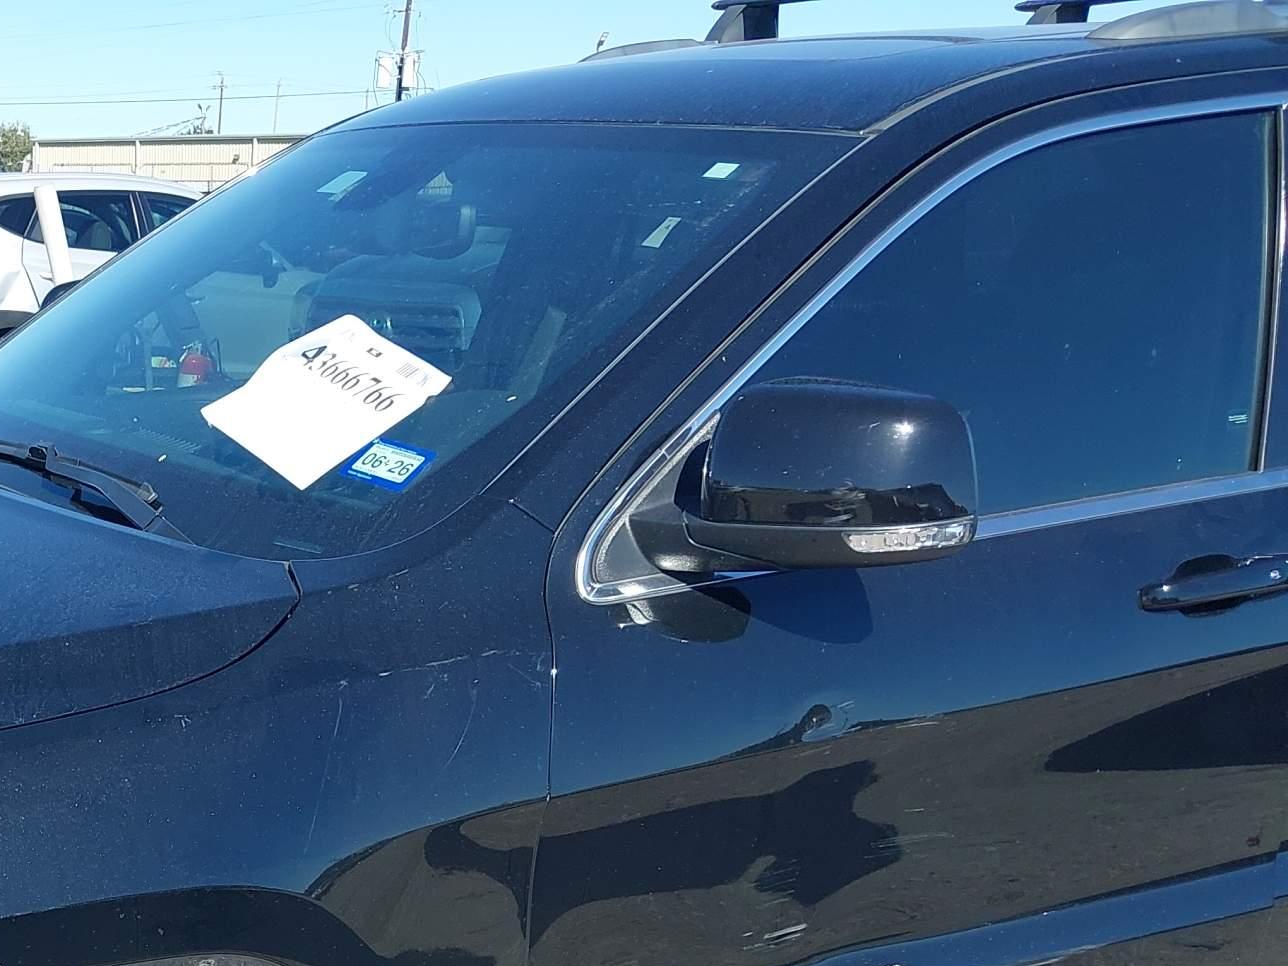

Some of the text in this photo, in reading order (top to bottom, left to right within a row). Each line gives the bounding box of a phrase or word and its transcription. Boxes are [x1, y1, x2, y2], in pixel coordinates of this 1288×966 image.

[300, 345, 408, 412] 43666766
[361, 453, 387, 469] 06
[387, 460, 414, 476] 26
